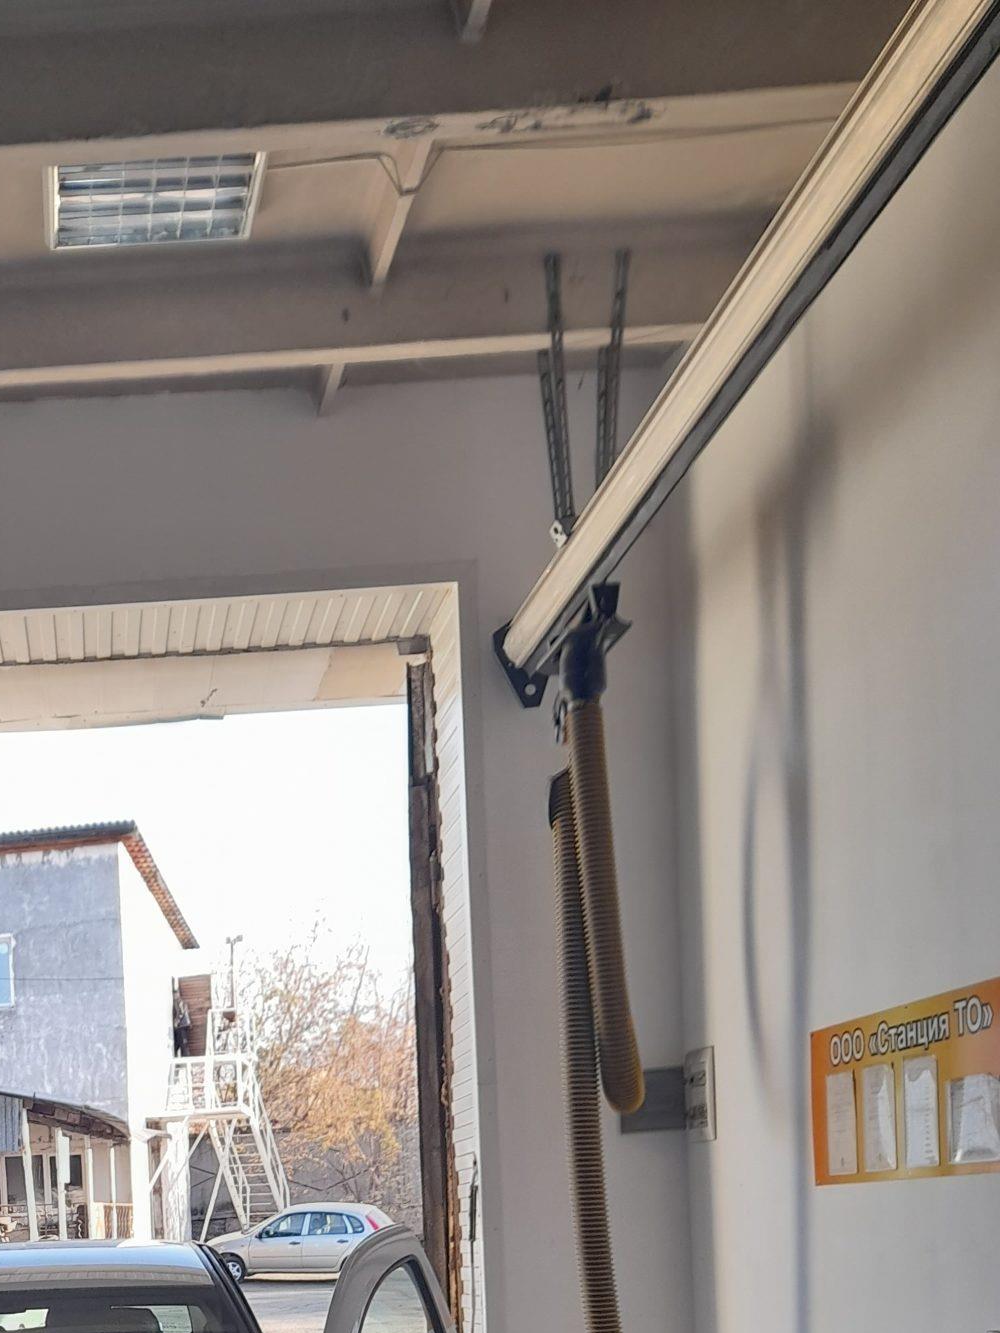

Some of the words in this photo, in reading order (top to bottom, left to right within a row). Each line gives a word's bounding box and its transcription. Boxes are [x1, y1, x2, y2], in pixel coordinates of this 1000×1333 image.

[830, 1028, 865, 1066] ООО
[868, 1012, 950, 1055] «Станция
[952, 995, 994, 1037] ТО»
